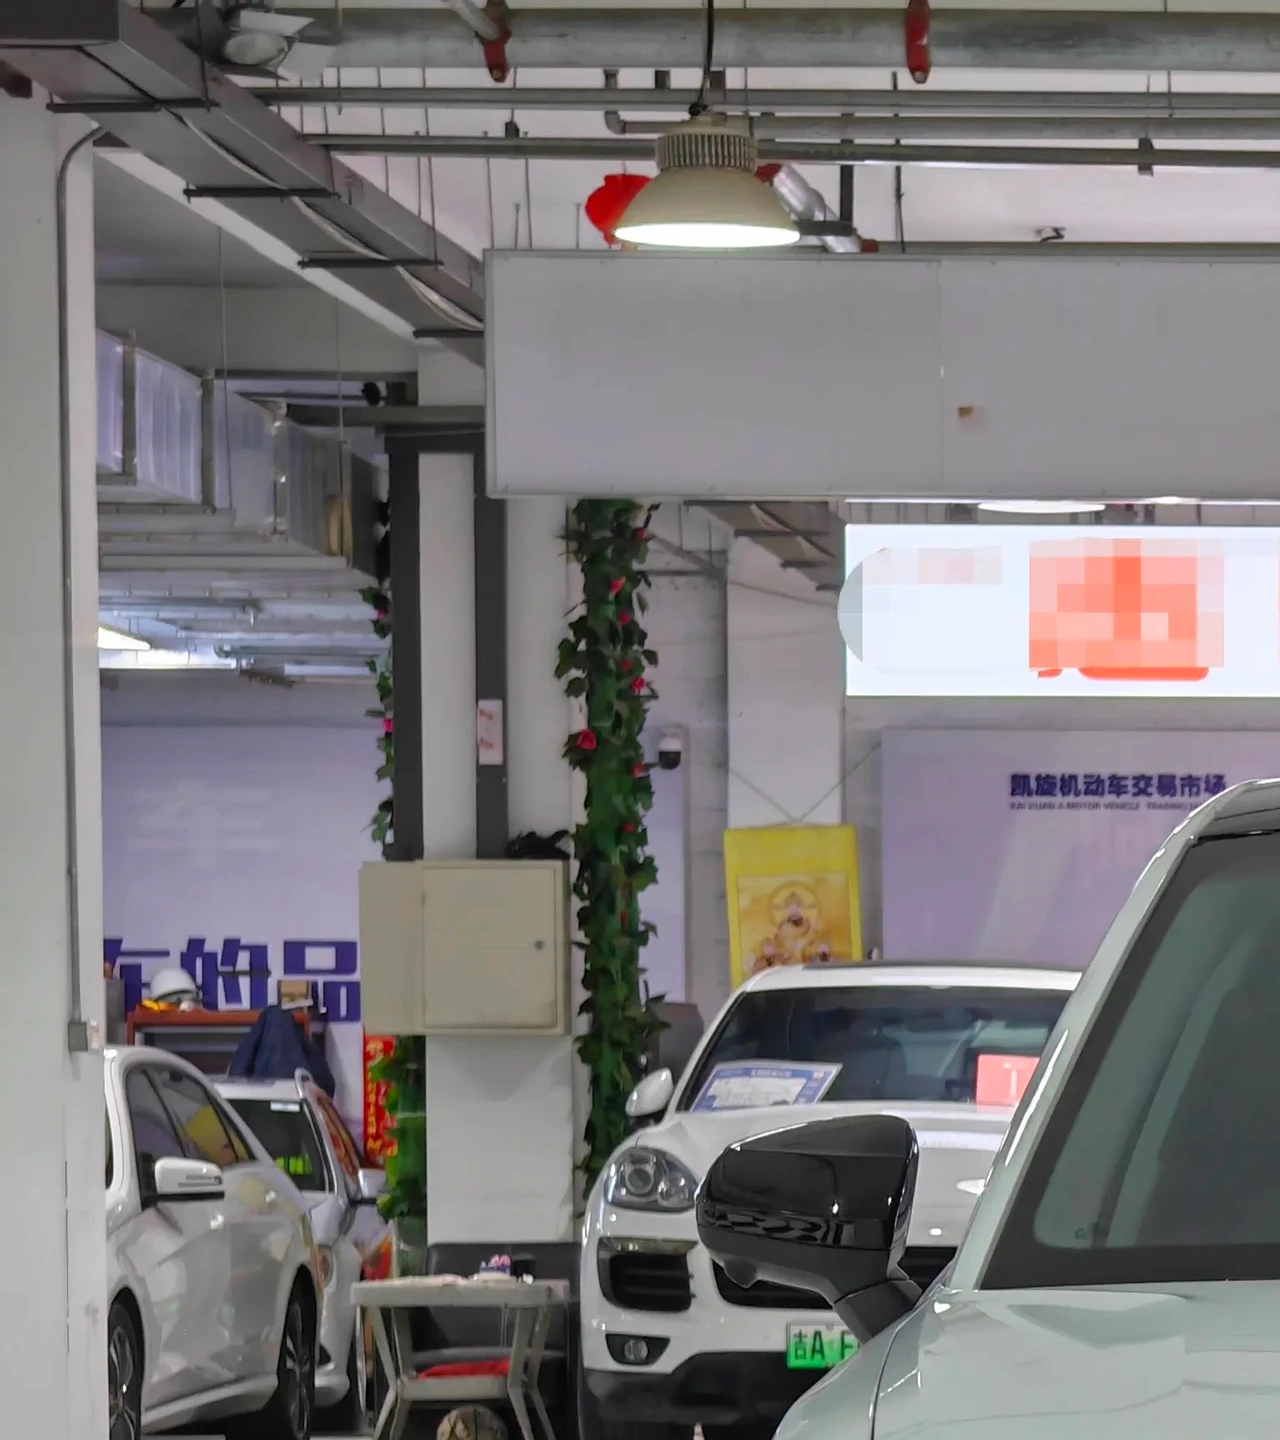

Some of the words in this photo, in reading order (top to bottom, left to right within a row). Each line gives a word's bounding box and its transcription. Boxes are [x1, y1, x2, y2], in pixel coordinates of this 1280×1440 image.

[1010, 773, 1226, 797] 凯旋机动车交易市场
